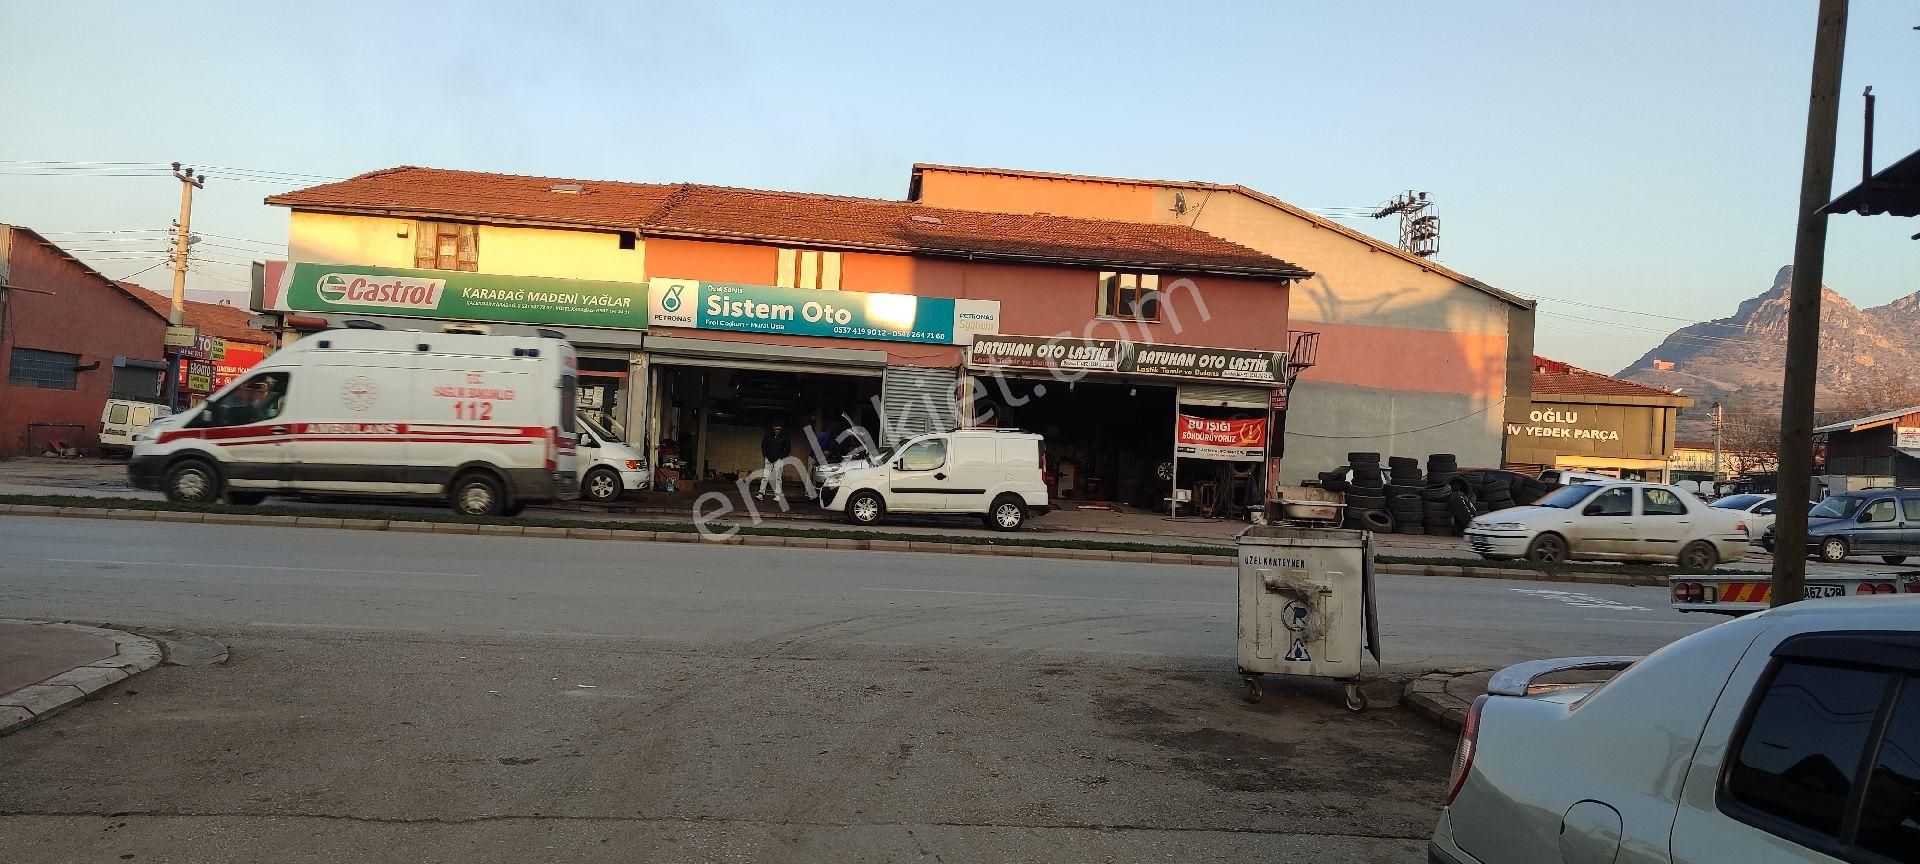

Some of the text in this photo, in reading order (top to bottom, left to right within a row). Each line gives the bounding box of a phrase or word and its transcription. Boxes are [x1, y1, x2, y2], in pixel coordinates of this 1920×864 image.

[347, 278, 436, 304] Castrol
[462, 287, 631, 308] KARABAĞ MADENİ YAĞLAR
[706, 294, 852, 324] Sistem Oto
[654, 314, 691, 323] PETRONAS
[833, 326, 851, 334] 0537
[852, 327, 866, 335] 419
[911, 331, 926, 339] 264
[974, 340, 1111, 361] BATUHAN OTO LASTİK
[1136, 365, 1159, 373] Lastik
[1137, 350, 1270, 372] BATUHAN OTO LASTİK
[453, 401, 494, 421] 112
[1529, 407, 1578, 424] OĞLU
[305, 423, 400, 434] AMBULANS
[1187, 420, 1204, 429] BU
[1524, 426, 1571, 438] YEDEK
[1573, 428, 1619, 442] PARÇA
